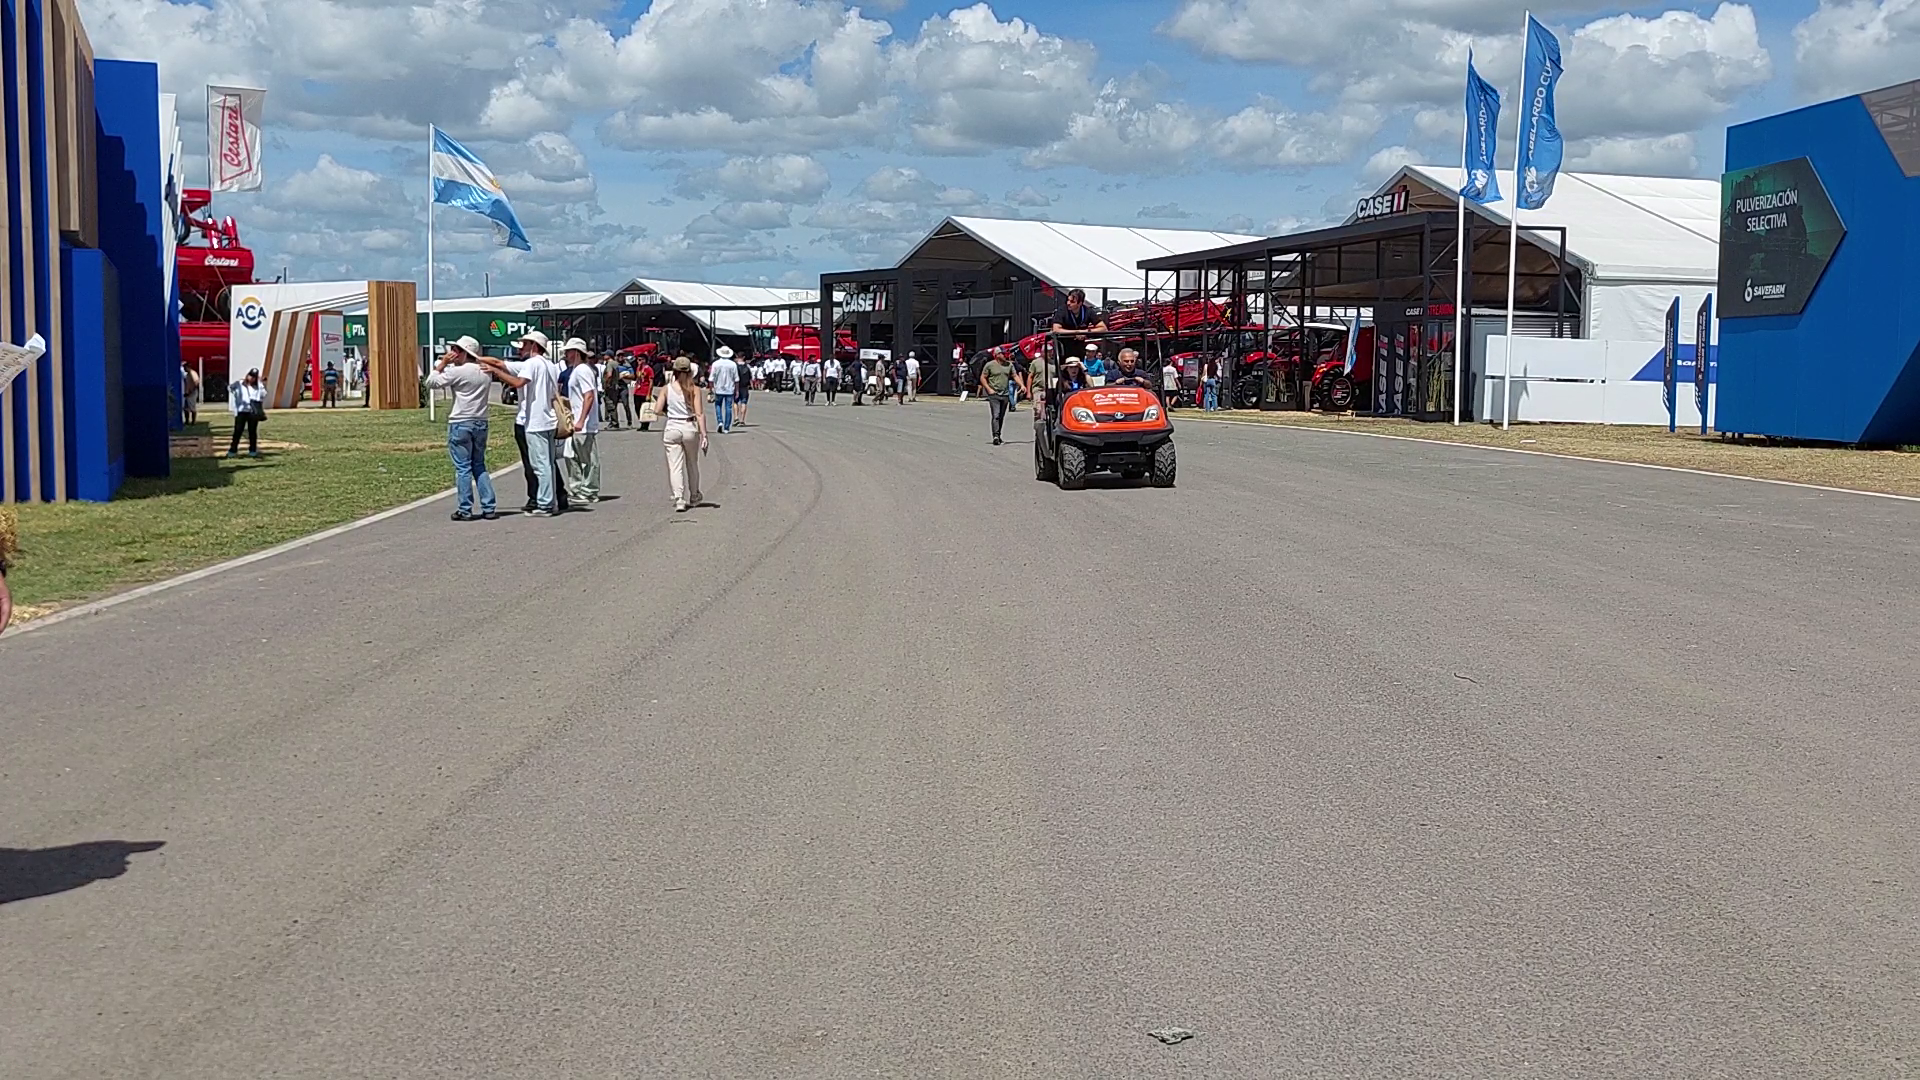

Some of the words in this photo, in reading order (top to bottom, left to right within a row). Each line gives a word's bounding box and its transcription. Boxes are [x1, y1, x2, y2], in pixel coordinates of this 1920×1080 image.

[223, 104, 241, 166] Cestari
[1357, 194, 1393, 219] CASE
[1736, 188, 1798, 213] PULVERIZACIÓN
[1746, 212, 1788, 232] SELECTIVA
[204, 254, 240, 267] Cestari
[1753, 283, 1786, 296] SAVEFARM
[235, 305, 267, 321] ACA
[842, 293, 874, 313] CASE
[1405, 308, 1419, 316] CASE
